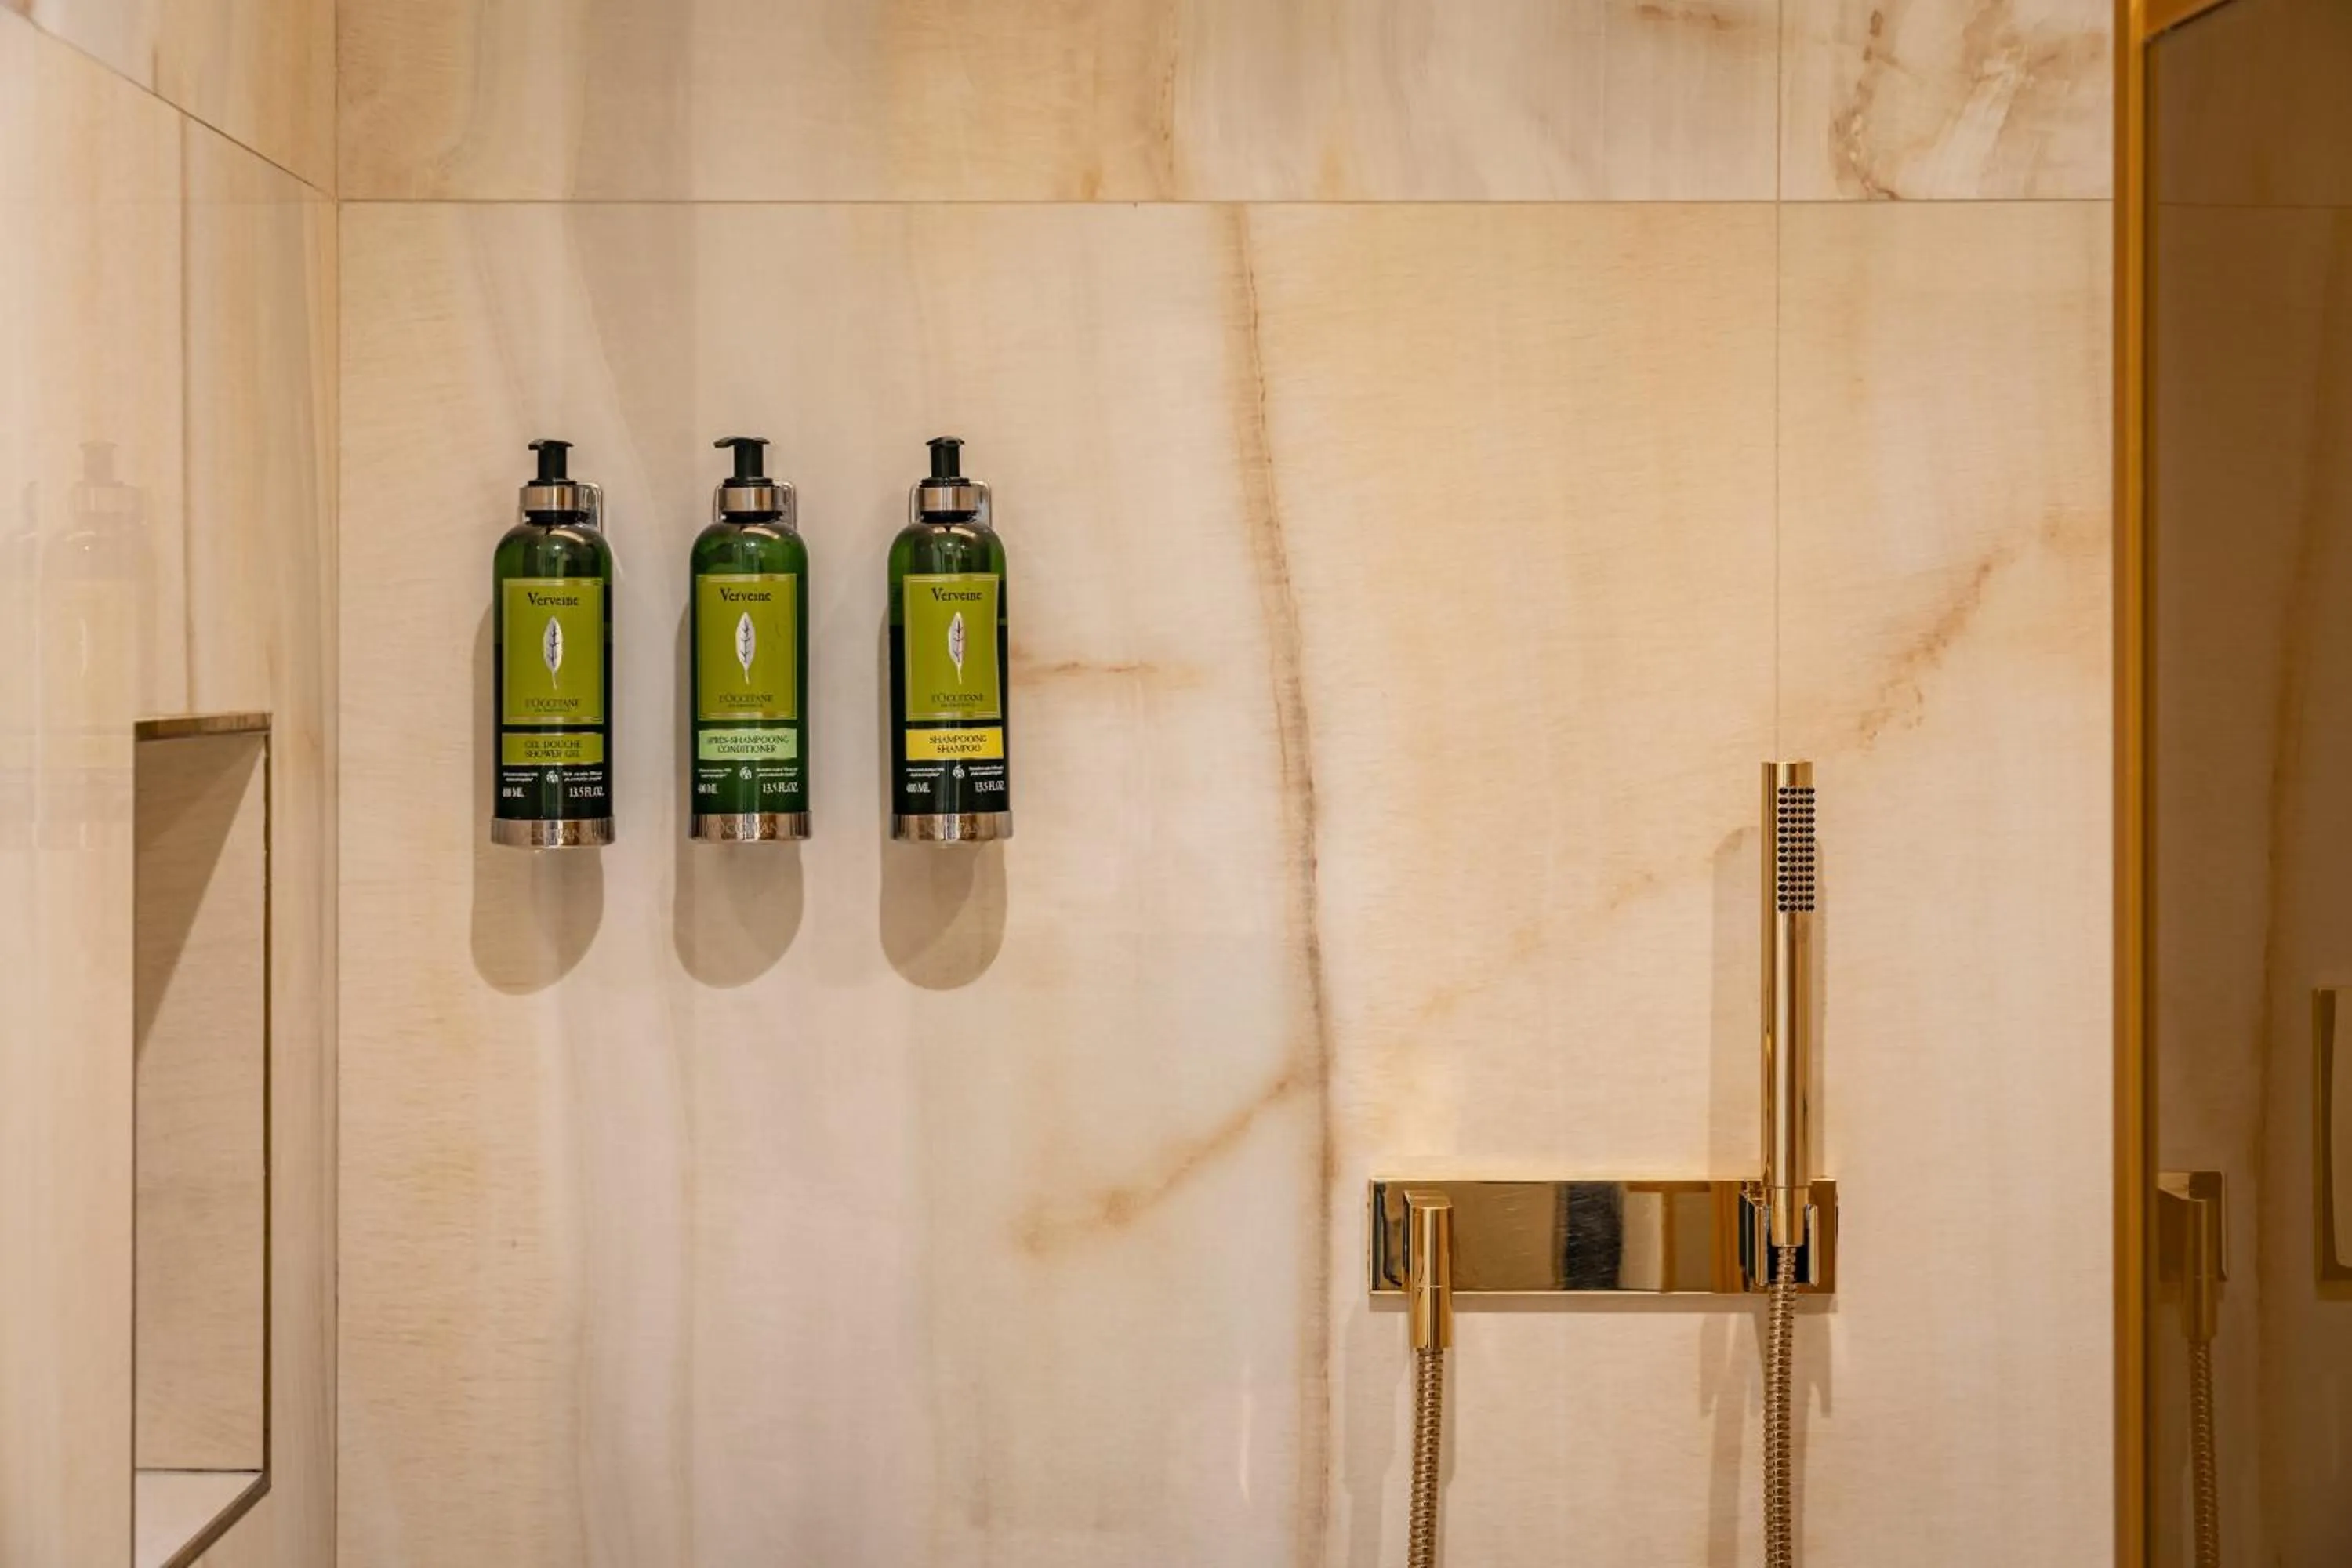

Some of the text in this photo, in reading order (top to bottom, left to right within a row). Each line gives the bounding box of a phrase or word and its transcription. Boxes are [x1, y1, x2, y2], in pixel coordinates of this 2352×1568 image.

[720, 587, 771, 601] Verveine
[931, 587, 982, 601] Verveine
[527, 592, 579, 606] Verveine
[929, 735, 987, 744] SHAMPOOING
[717, 744, 777, 753] CONDITIONER
[936, 744, 982, 753] SHAMPOO
[525, 750, 562, 758] SHOWER
